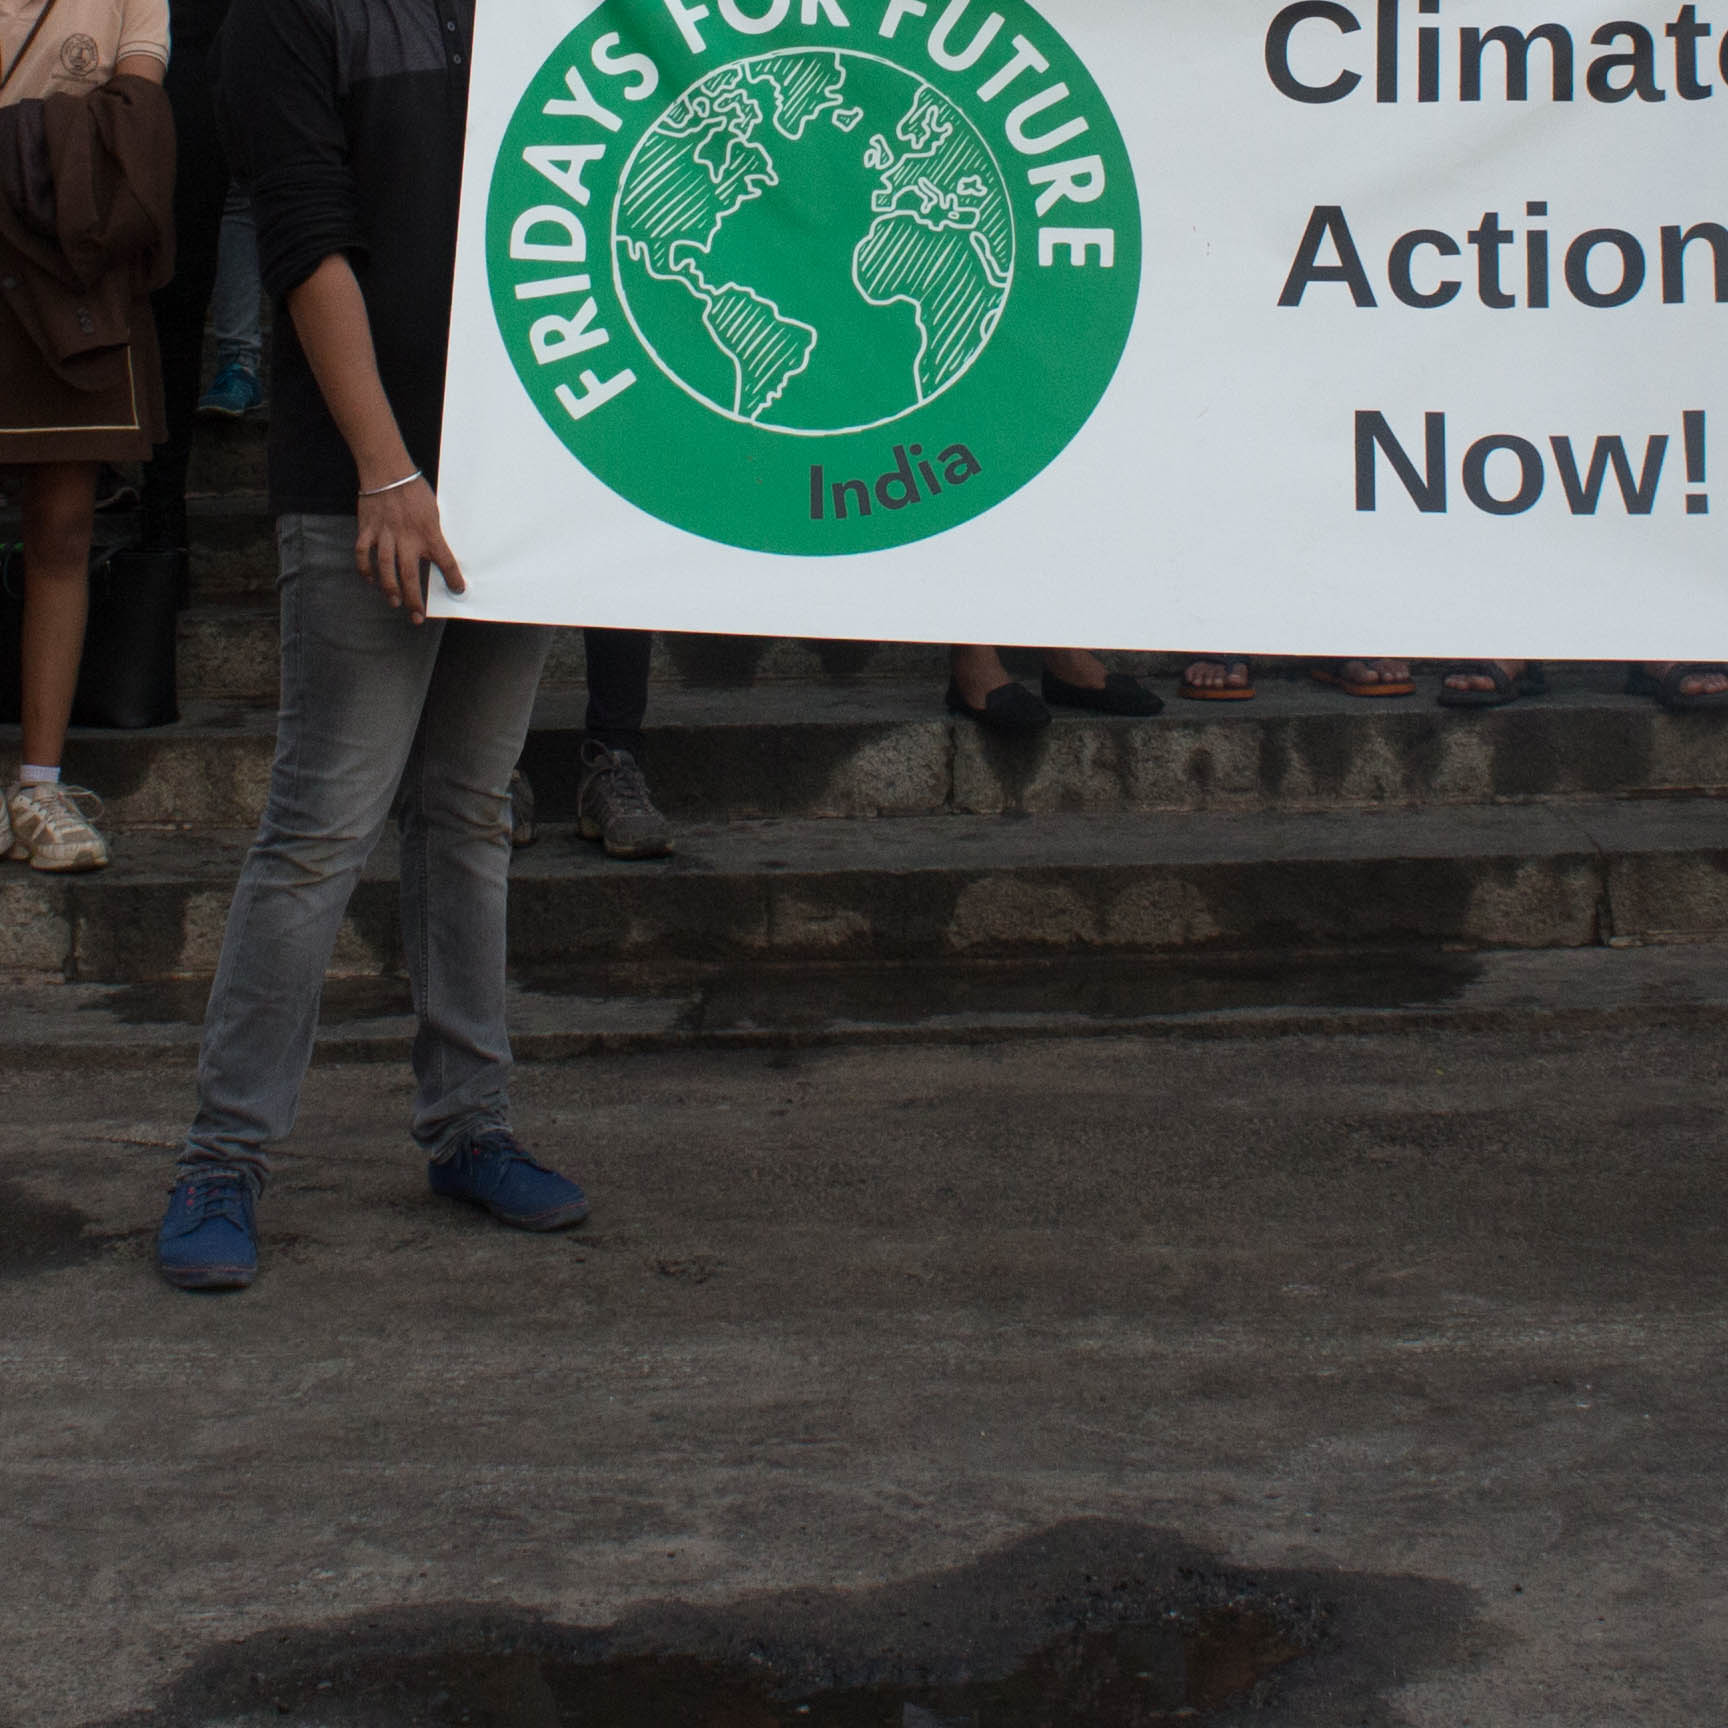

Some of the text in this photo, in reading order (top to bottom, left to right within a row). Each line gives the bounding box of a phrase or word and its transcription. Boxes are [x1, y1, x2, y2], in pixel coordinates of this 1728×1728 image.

[509, 31, 659, 421] FRIDAYS
[808, 441, 982, 521] India
[1354, 410, 1709, 516] Now!
